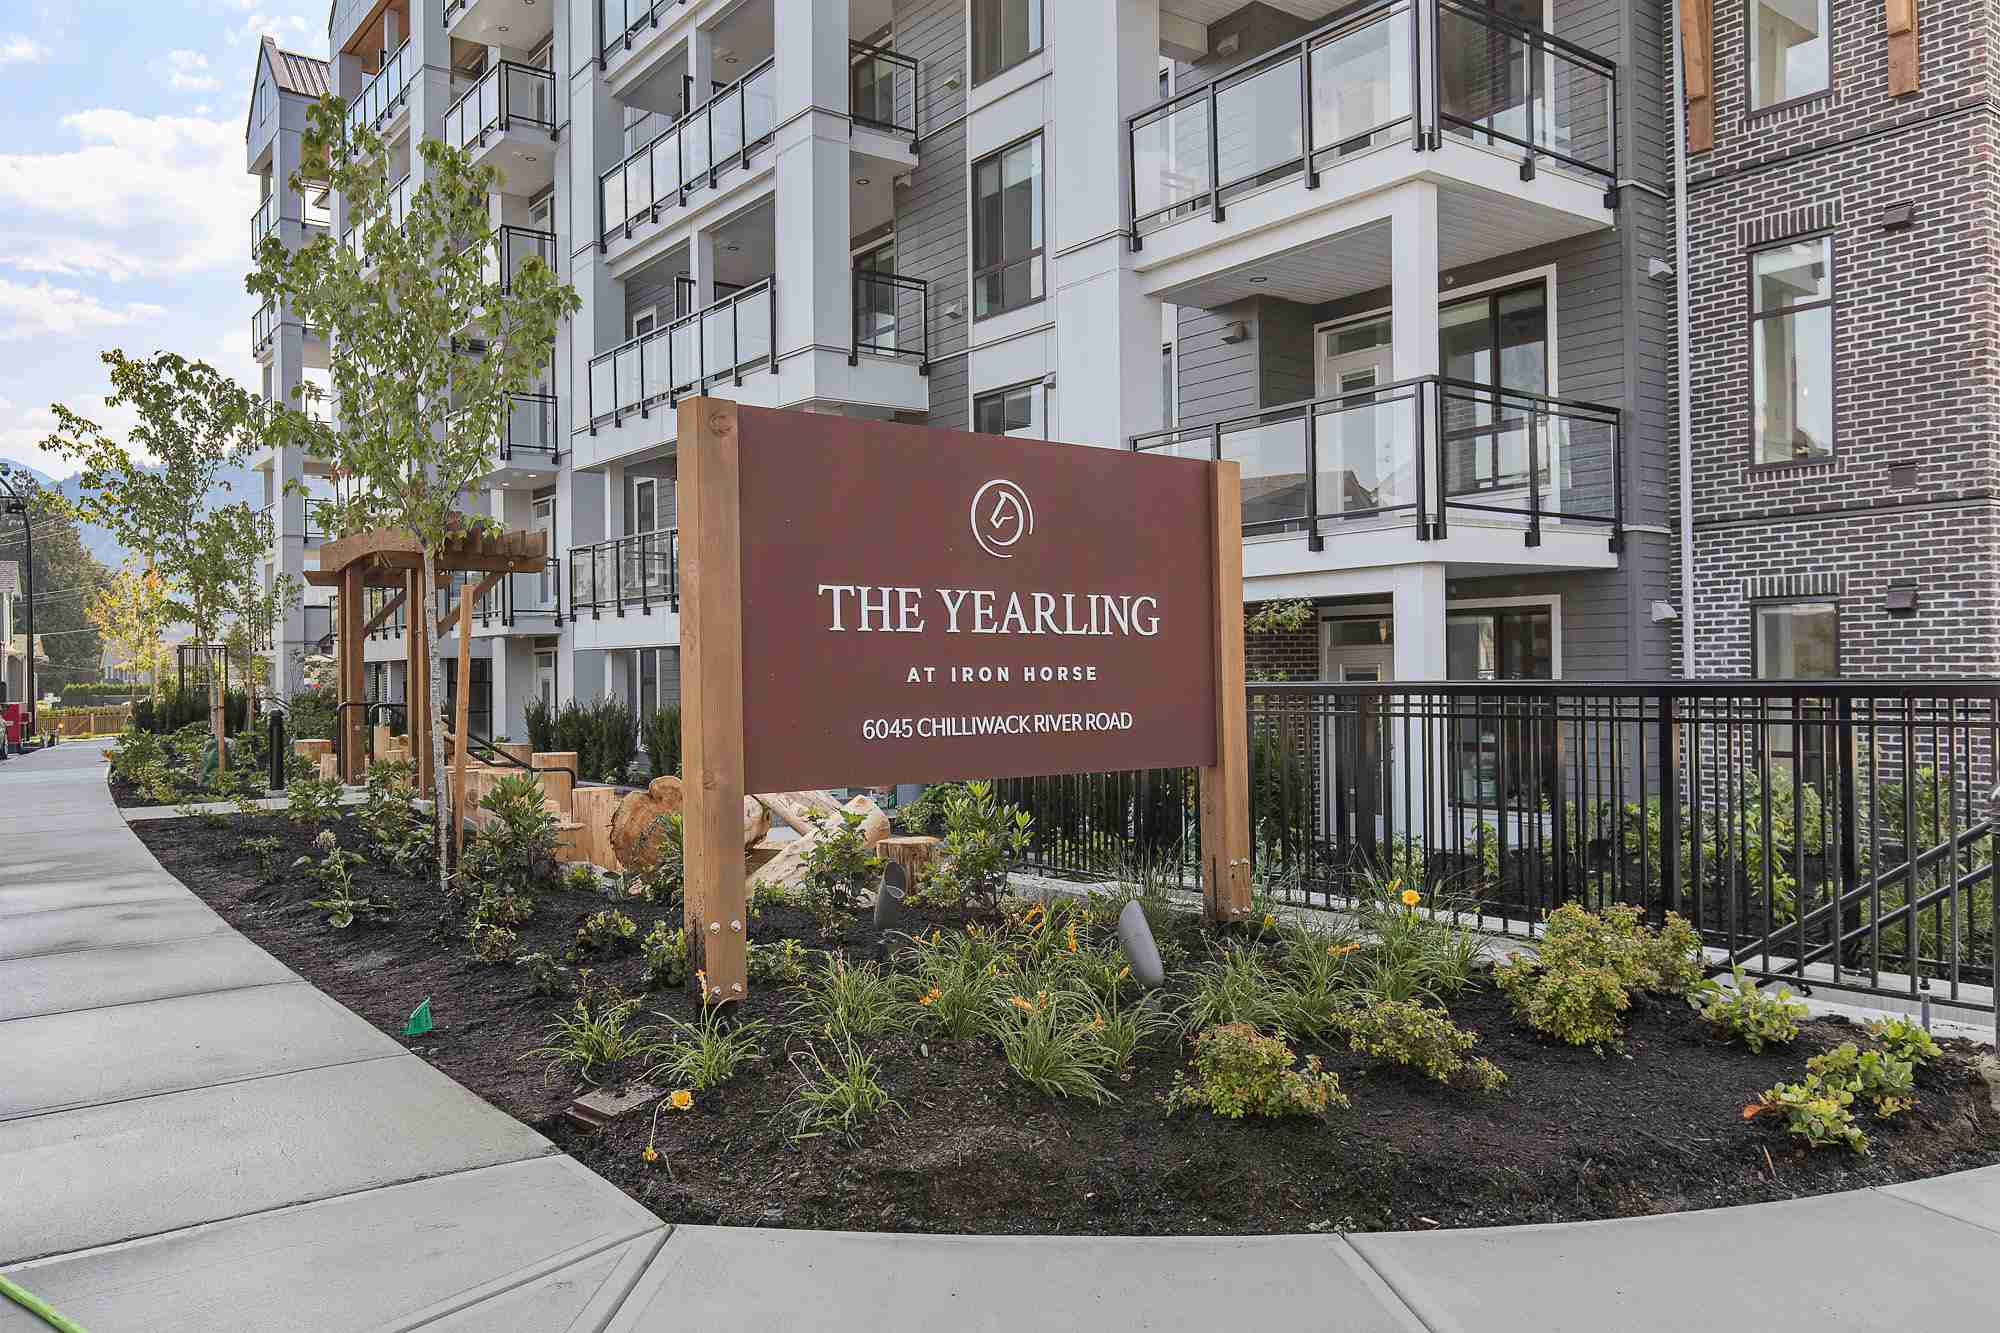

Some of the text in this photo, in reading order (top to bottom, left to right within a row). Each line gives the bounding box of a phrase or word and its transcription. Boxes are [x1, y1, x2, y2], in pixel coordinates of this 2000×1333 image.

[818, 584, 1161, 636] THE YEARLING
[906, 665, 1097, 683] AT IRON HORSE
[862, 712, 1133, 740] 6045 CHILLIWACK RIVER ROAD
